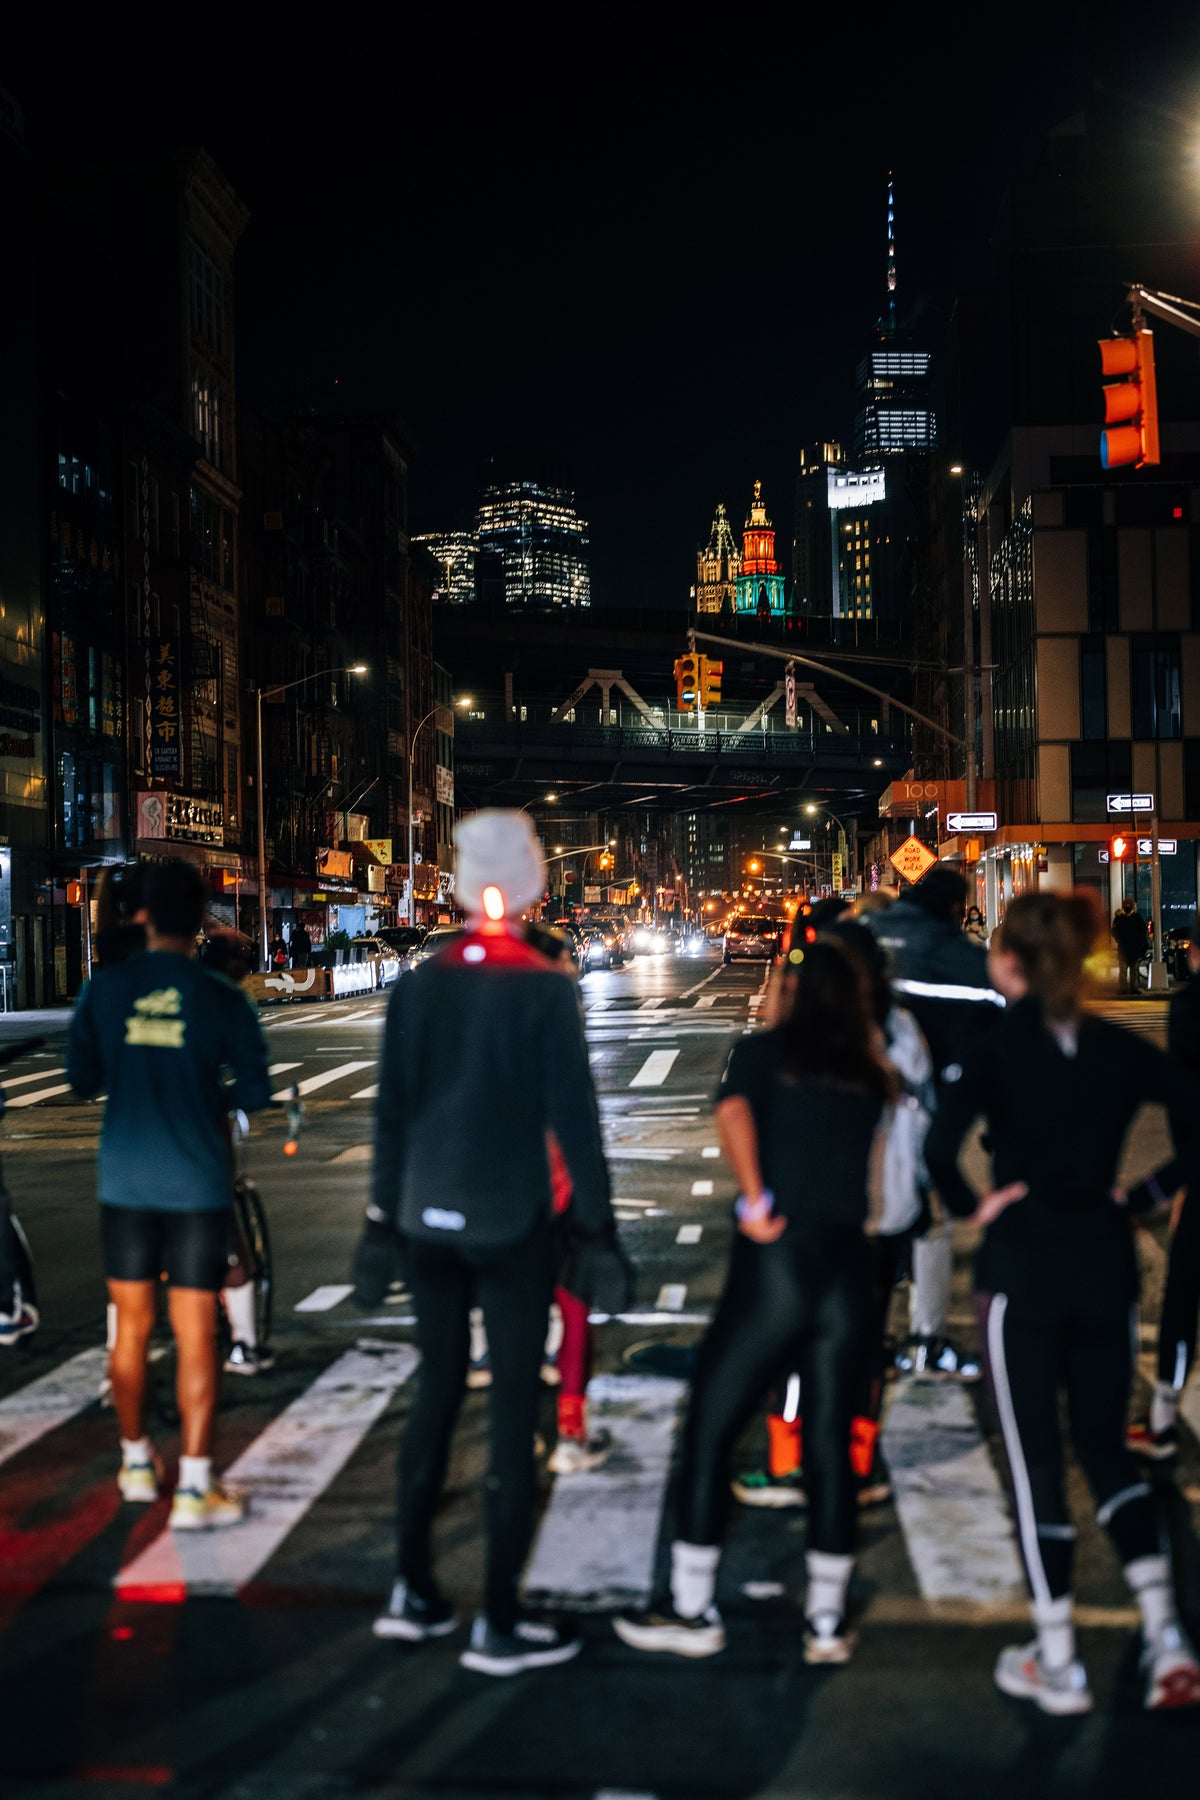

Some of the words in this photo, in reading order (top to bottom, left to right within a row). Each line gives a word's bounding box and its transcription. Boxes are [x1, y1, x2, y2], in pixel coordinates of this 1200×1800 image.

[156, 641, 177, 744] 美東超市
[904, 783, 938, 798] 100
